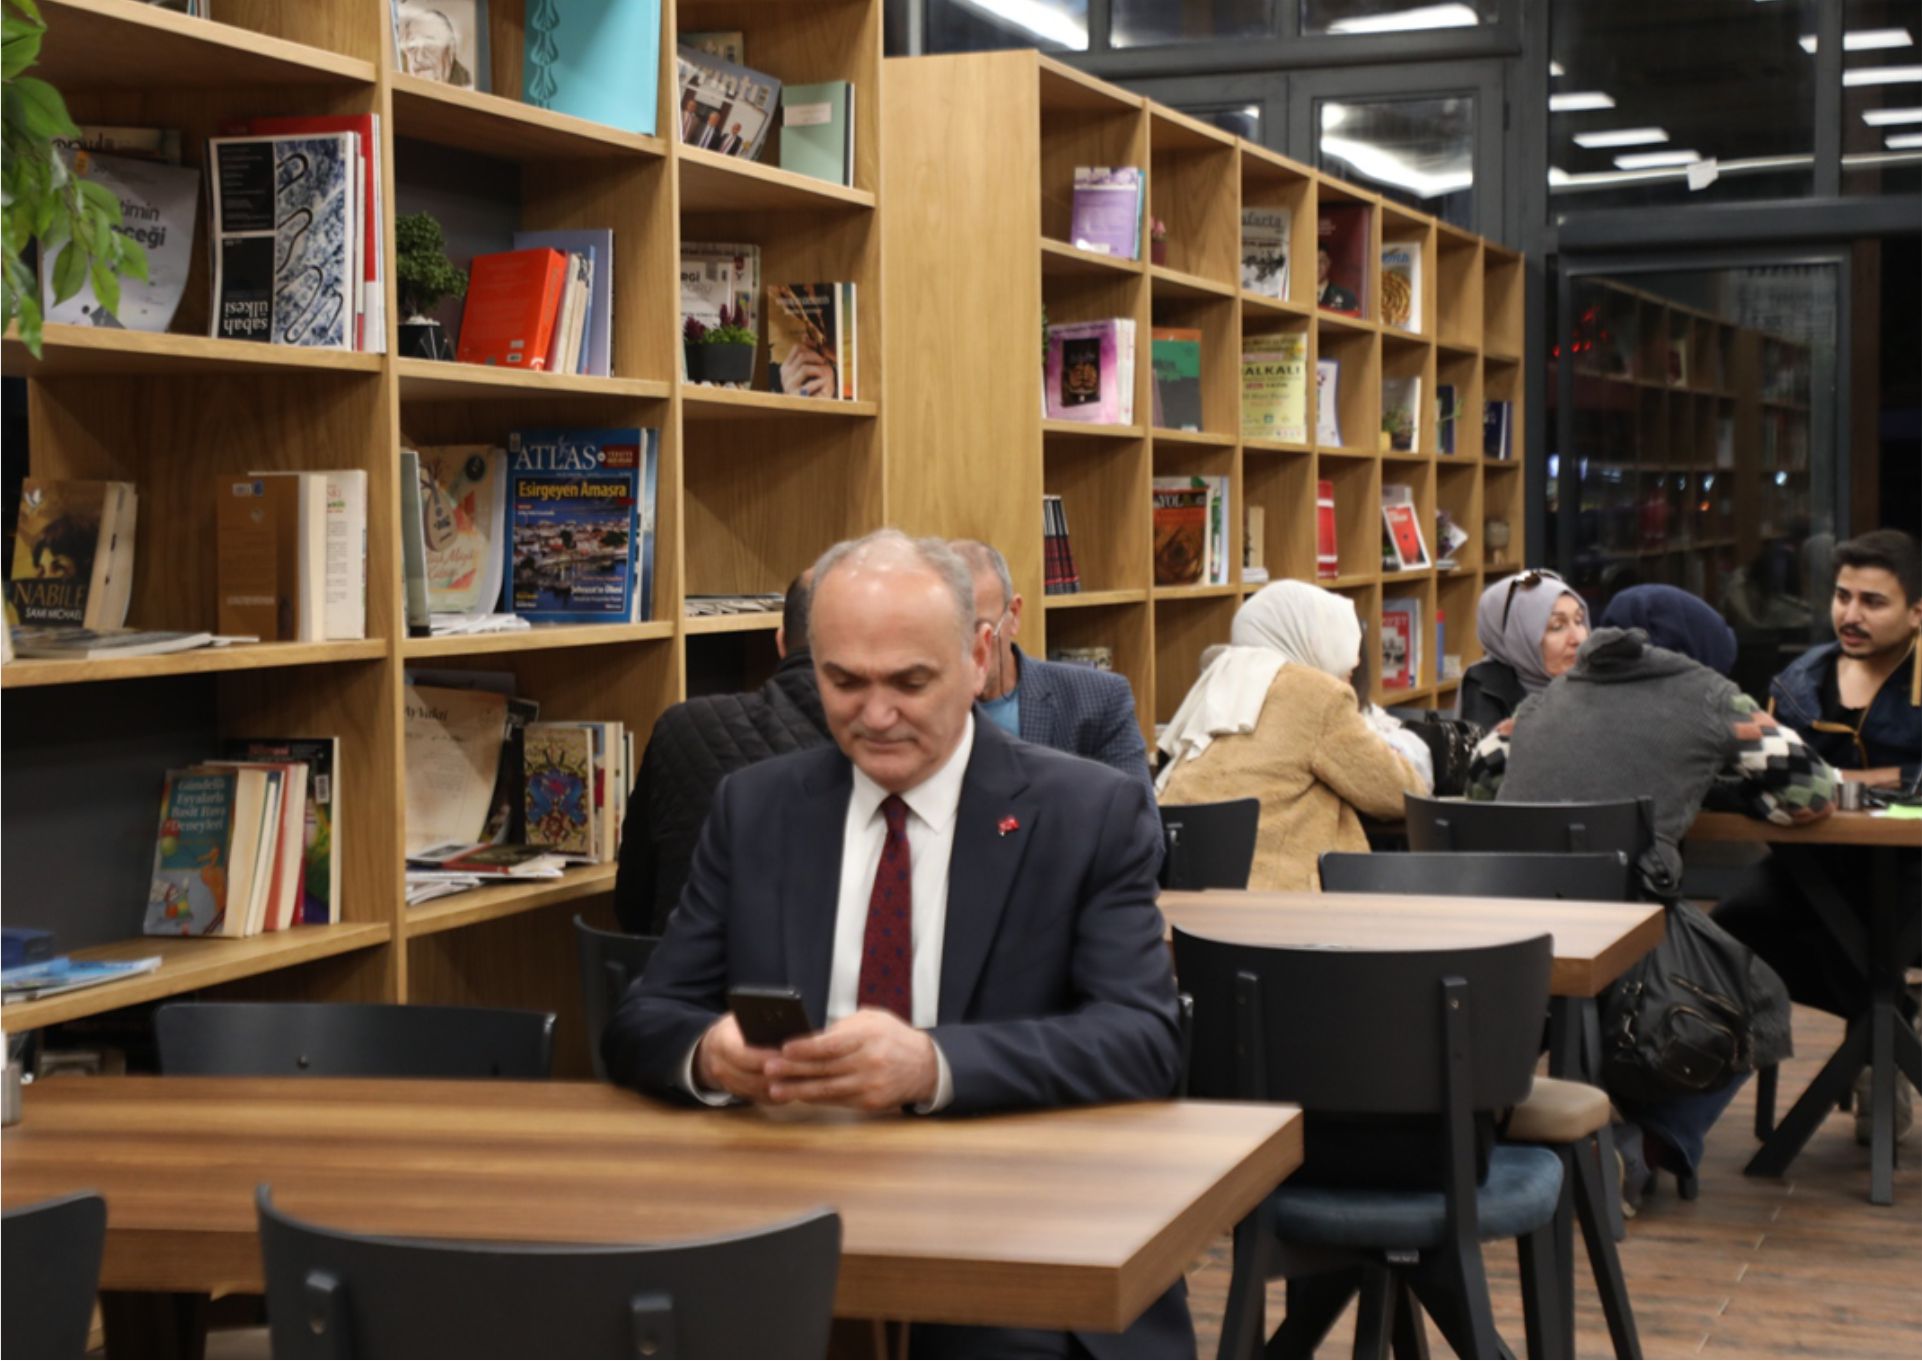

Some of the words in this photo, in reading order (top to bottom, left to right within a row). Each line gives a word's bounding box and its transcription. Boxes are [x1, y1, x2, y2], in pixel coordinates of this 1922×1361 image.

[223, 318, 268, 336] sabah
[513, 445, 597, 471] ATLAS
[519, 481, 579, 501] Esirgeyen
[581, 481, 627, 498] Amasra
